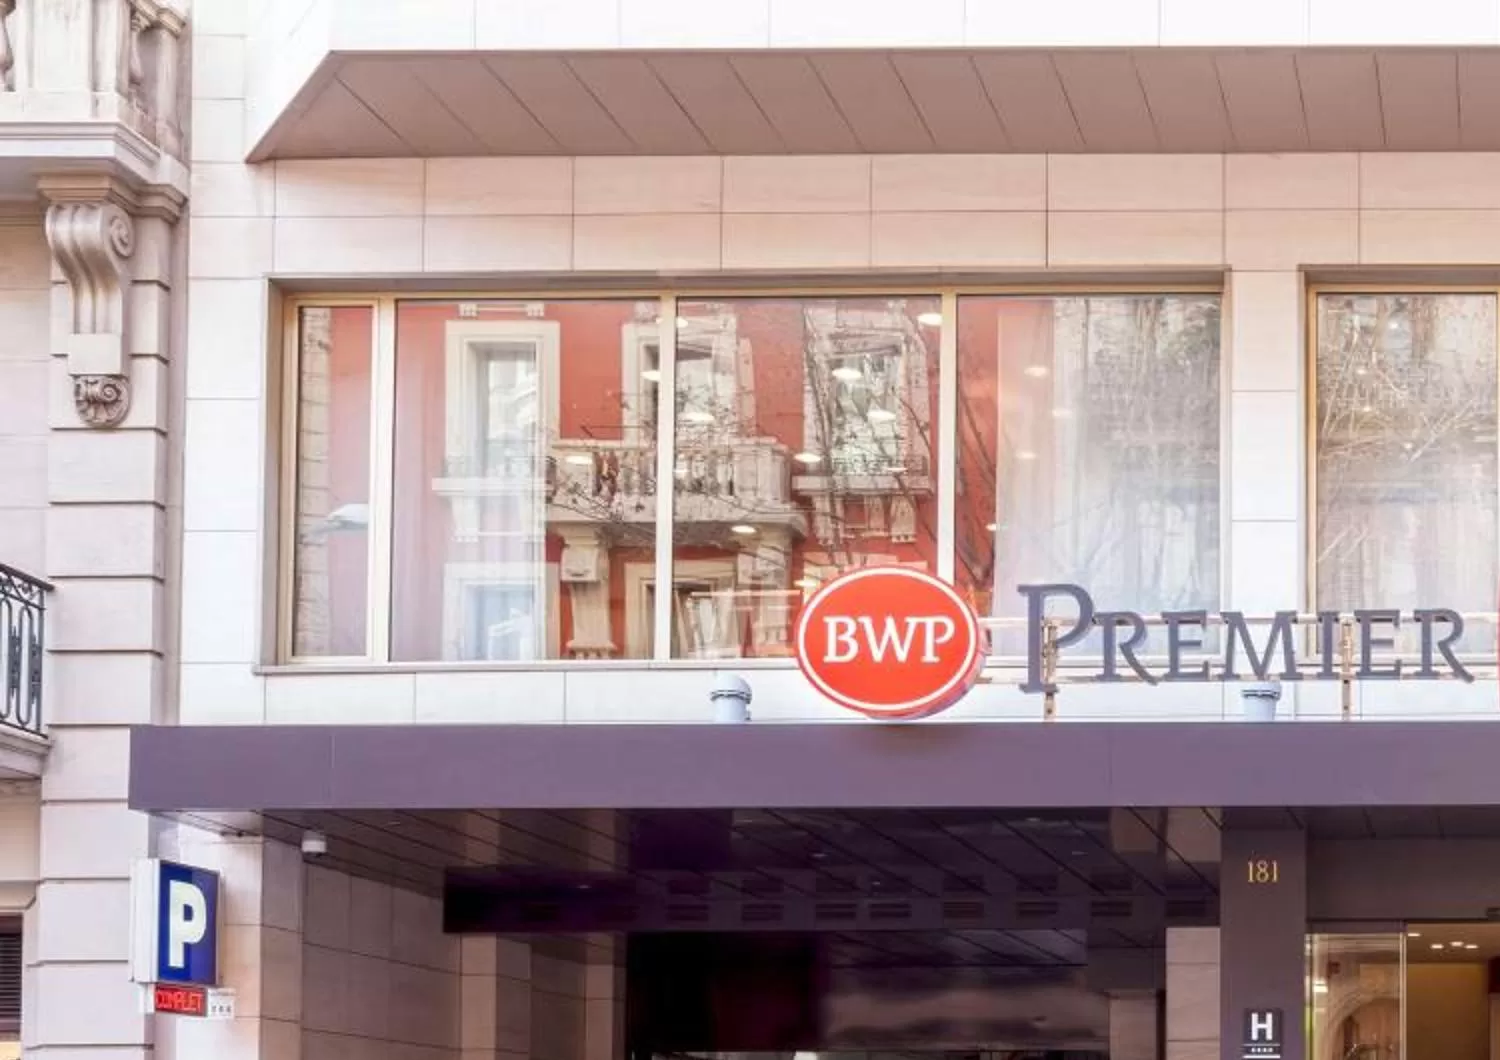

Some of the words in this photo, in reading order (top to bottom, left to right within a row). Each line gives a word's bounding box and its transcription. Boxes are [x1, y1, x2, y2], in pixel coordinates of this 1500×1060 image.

[823, 614, 956, 664] BWP
[1016, 582, 1475, 694] PREMIER
[1247, 860, 1279, 884] 181
[168, 879, 207, 968] P
[1250, 1012, 1274, 1042] H
